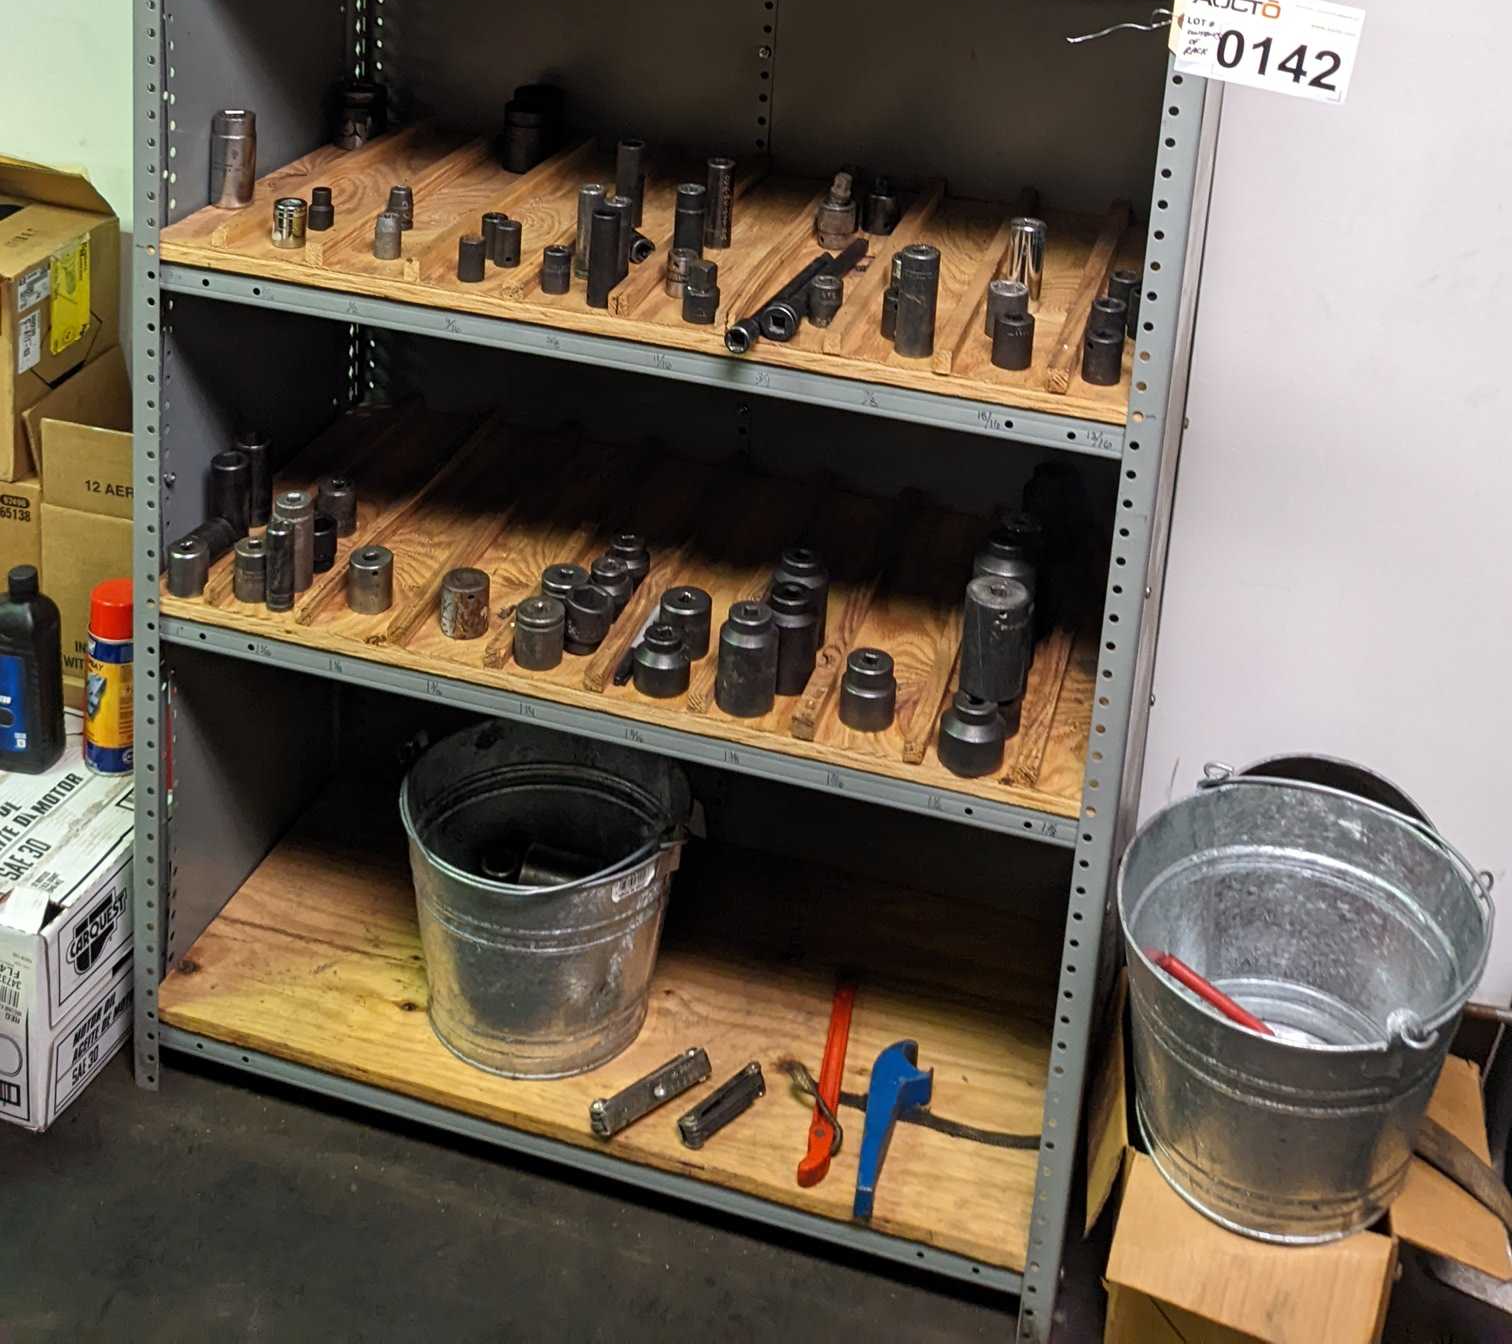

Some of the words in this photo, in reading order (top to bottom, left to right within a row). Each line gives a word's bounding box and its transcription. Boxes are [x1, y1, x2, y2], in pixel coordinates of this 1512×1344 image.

[1187, 16, 1206, 27] LOT
[1216, 29, 1342, 92] 0142
[85, 480, 101, 494] 12
[31, 772, 84, 815] MOTOR
[0, 853, 34, 881] SAE
[18, 838, 52, 859] 30
[69, 890, 126, 958] CARQUEST
[72, 1057, 87, 1087] SAE
[88, 1044, 99, 1069] 30
